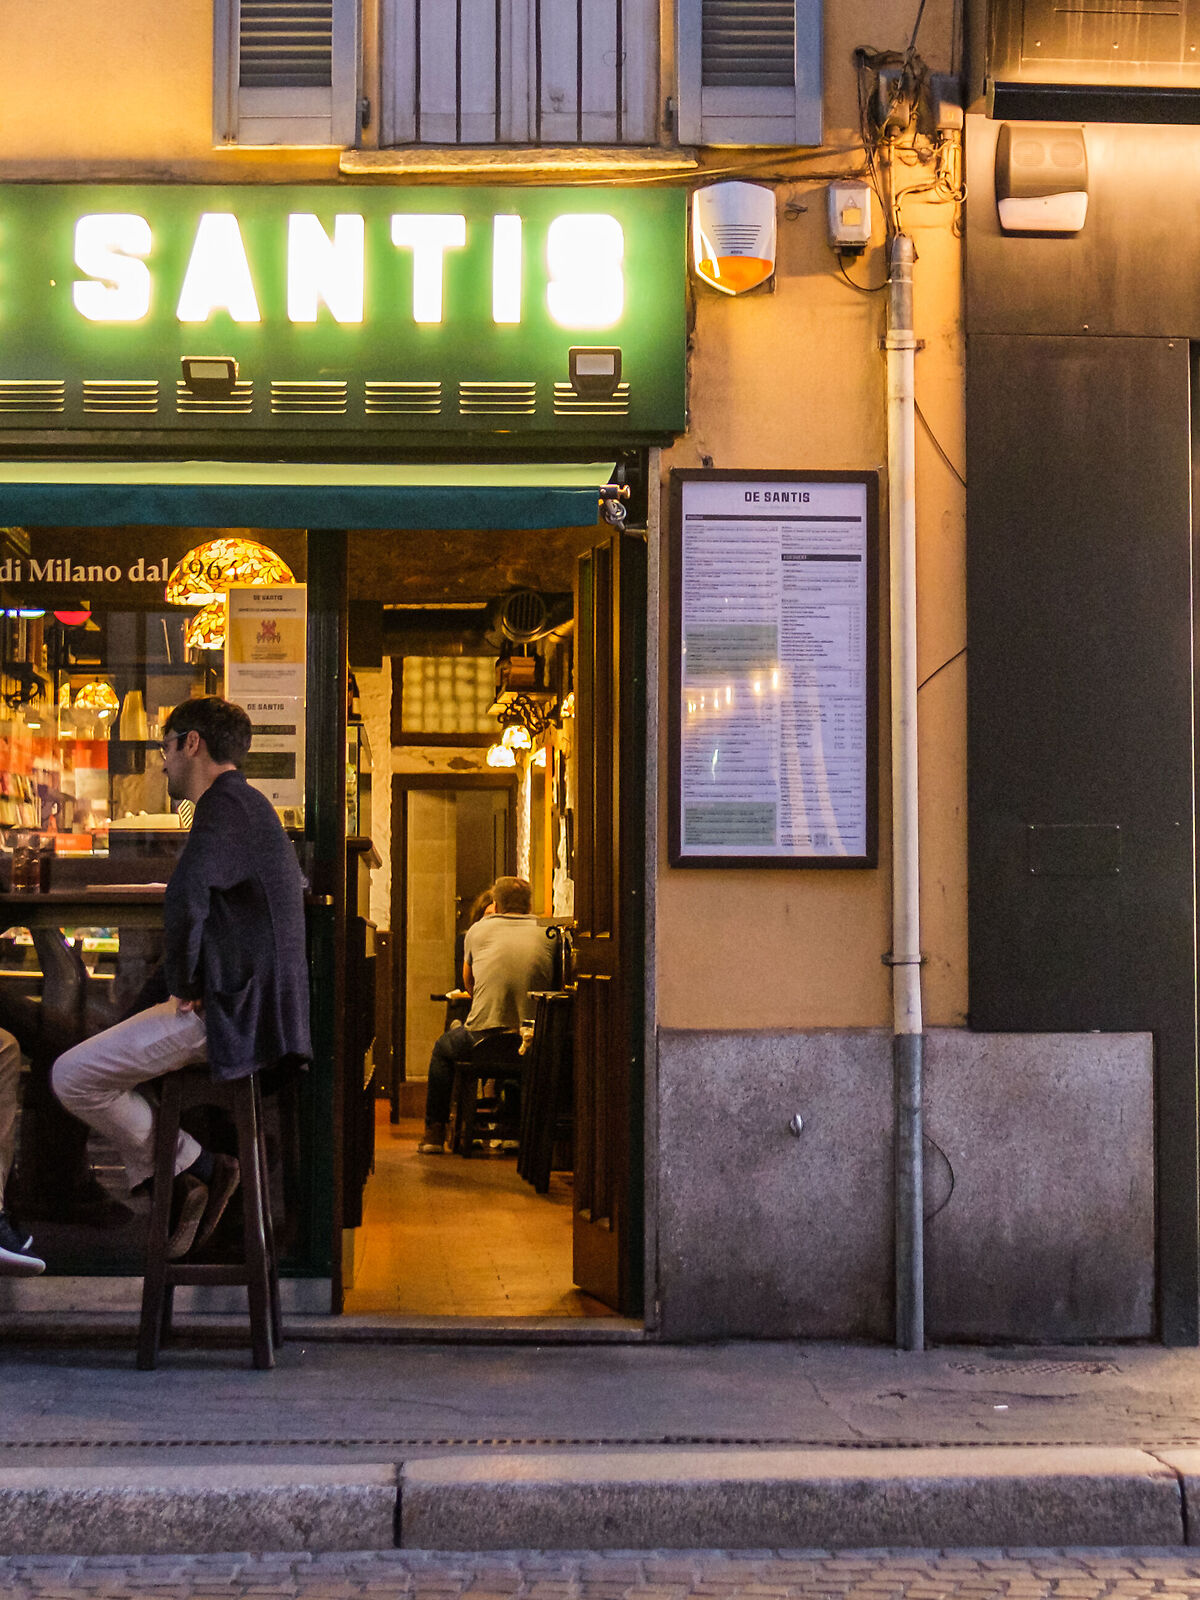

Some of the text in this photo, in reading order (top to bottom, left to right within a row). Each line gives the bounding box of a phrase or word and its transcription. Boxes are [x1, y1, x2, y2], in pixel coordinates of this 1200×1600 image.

[72, 211, 626, 330] SANTIS
[744, 491, 810, 503] DE SANTIS
[29, 557, 122, 582] Milano
[127, 557, 169, 582] dal
